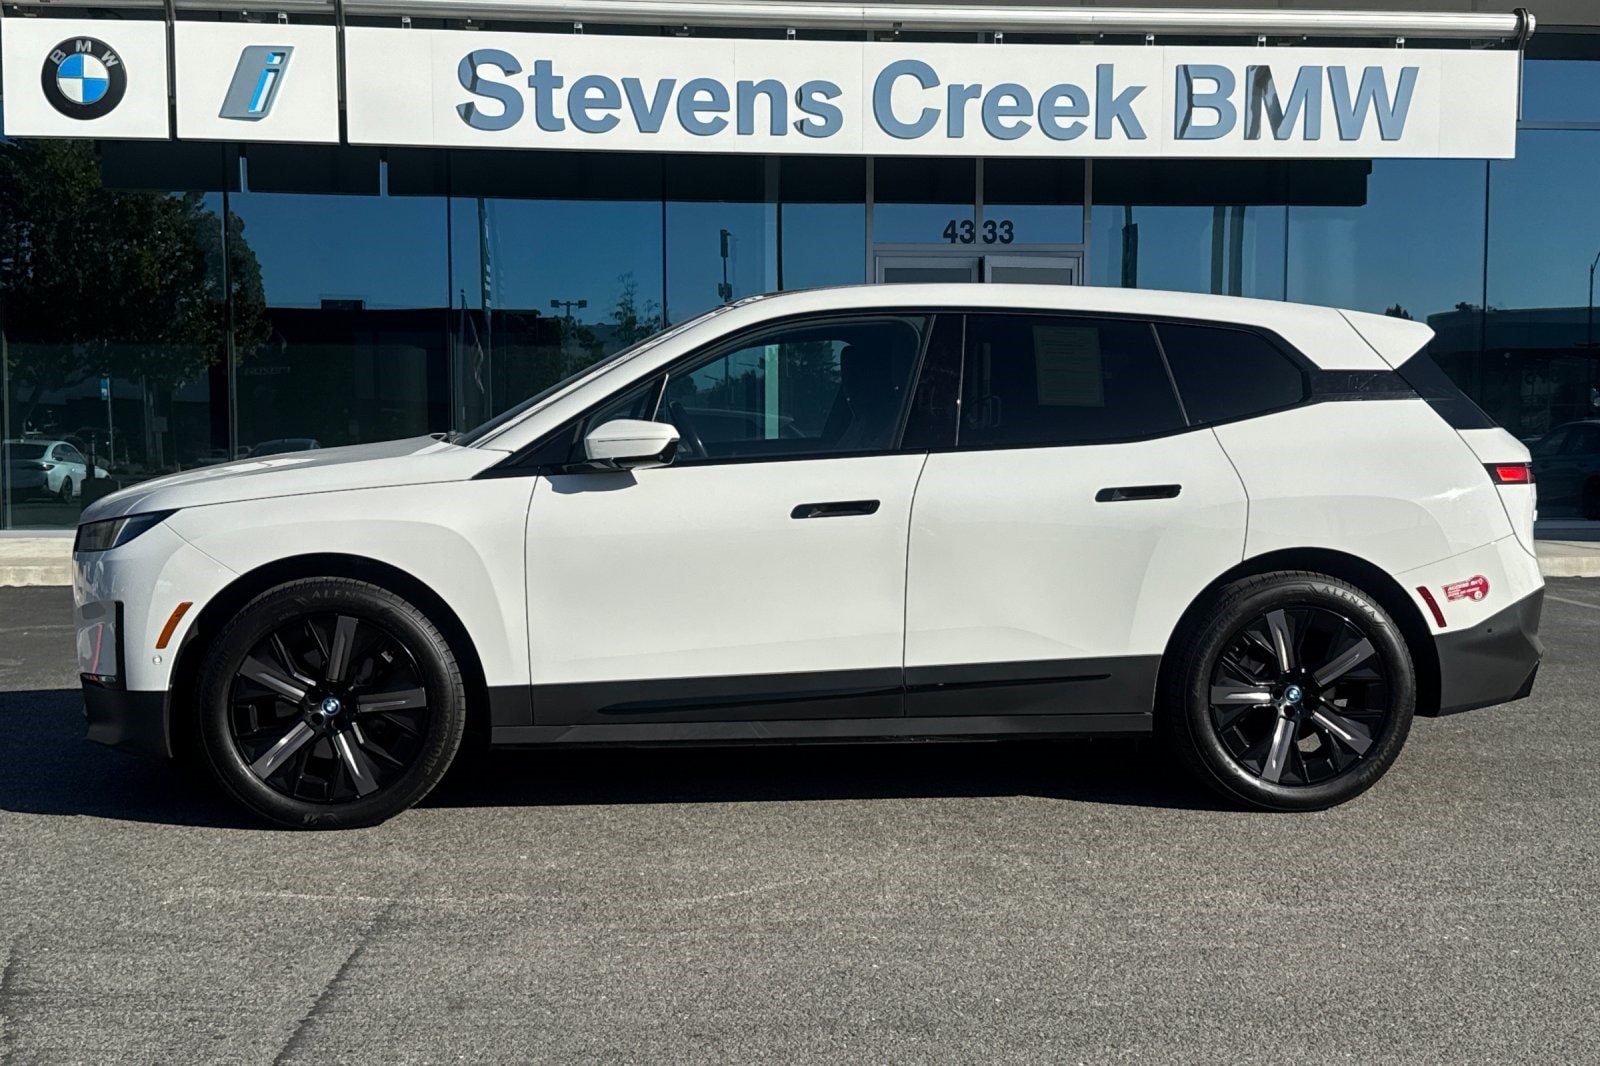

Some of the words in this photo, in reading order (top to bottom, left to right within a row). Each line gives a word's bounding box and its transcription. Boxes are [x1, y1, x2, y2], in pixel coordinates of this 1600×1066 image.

[50, 40, 119, 67] BMW
[456, 49, 844, 139] Stevens
[873, 60, 1148, 142] Creek
[1174, 64, 1419, 142] BMW
[1322, 586, 1376, 619] ALENZA
